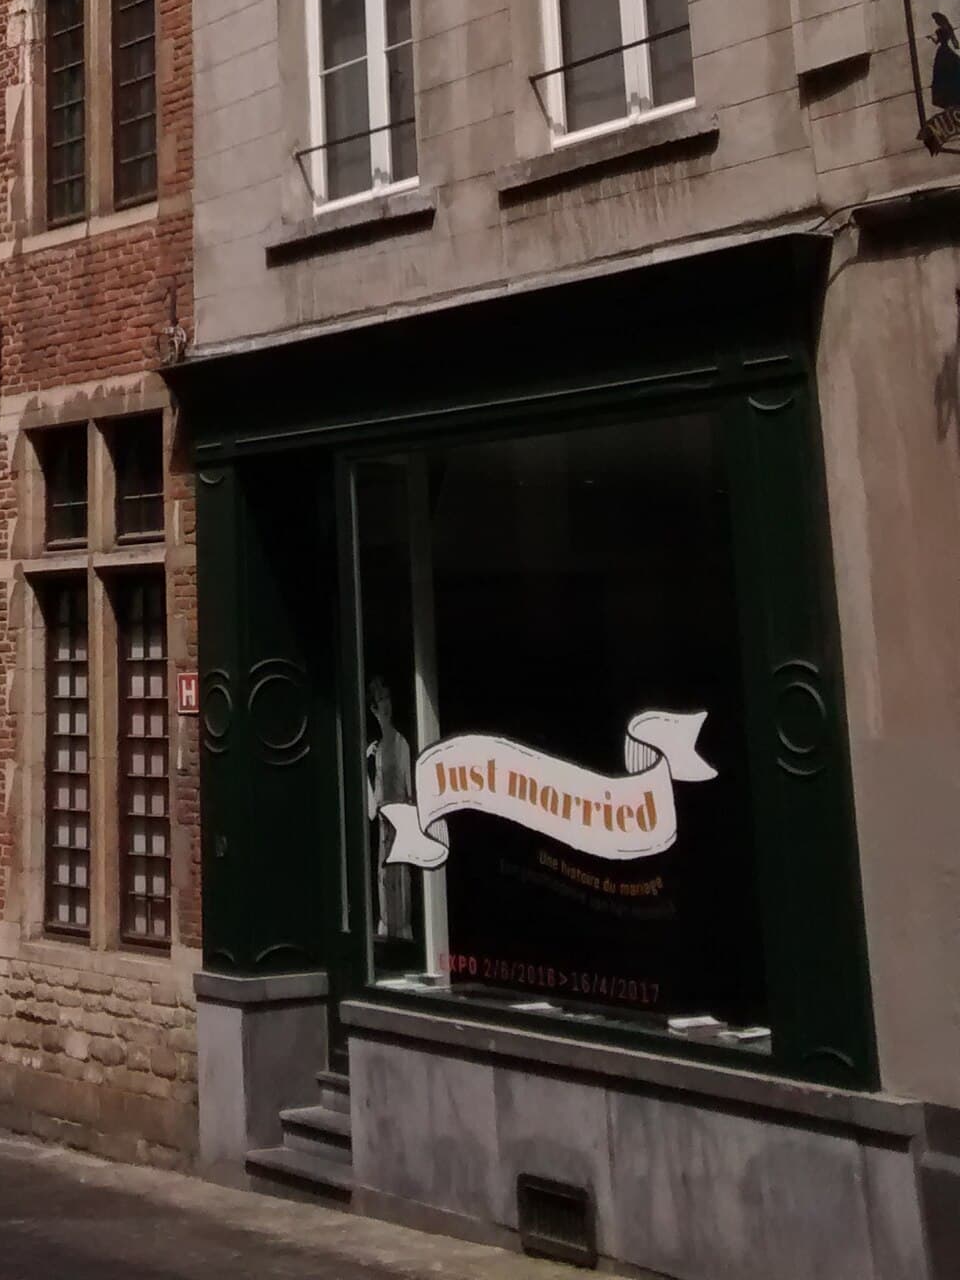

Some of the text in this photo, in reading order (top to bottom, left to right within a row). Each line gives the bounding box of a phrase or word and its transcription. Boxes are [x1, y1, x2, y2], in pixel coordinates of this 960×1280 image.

[182, 679, 196, 707] H
[432, 757, 657, 834] Just married
[438, 952, 477, 976] EXPO
